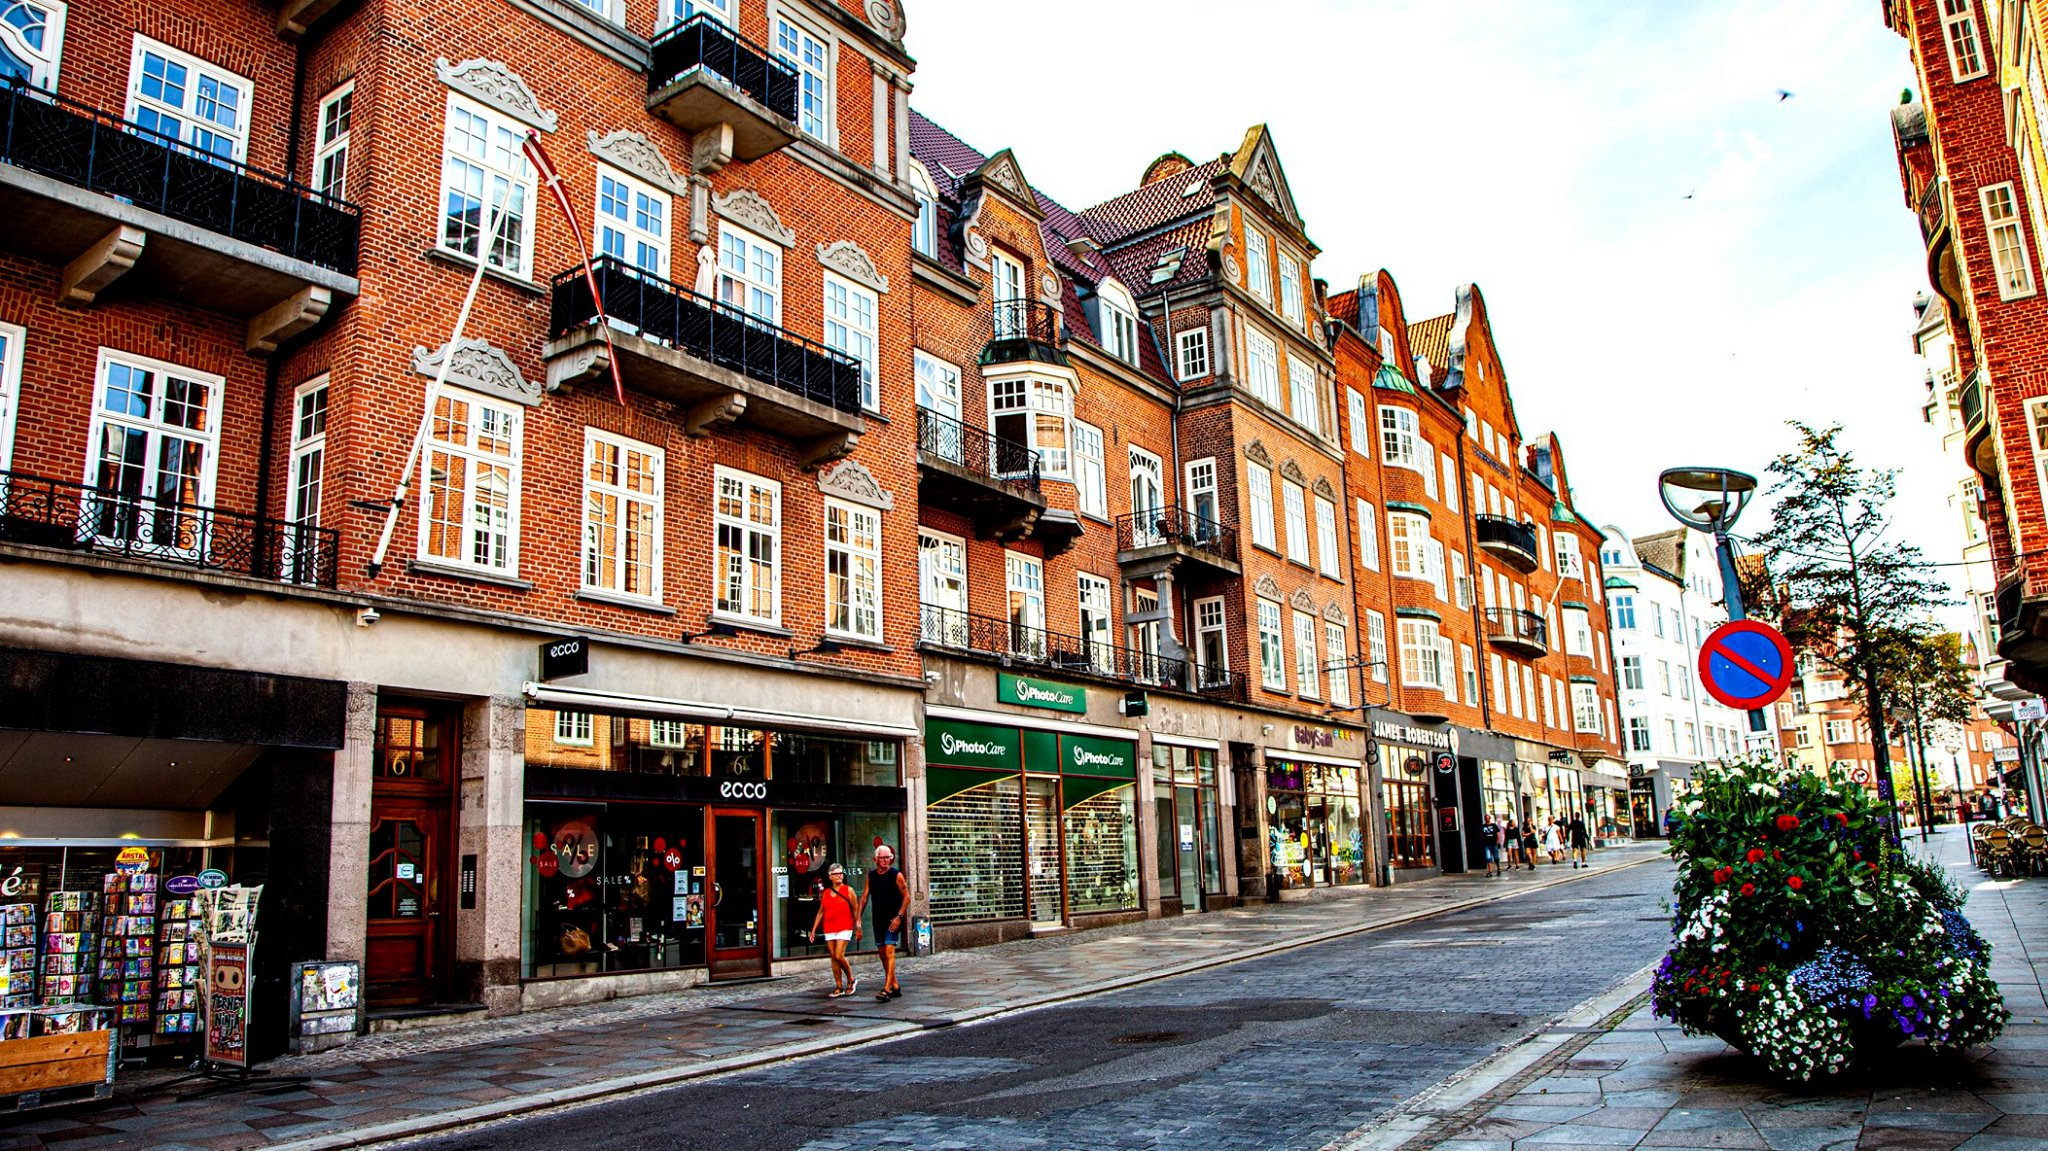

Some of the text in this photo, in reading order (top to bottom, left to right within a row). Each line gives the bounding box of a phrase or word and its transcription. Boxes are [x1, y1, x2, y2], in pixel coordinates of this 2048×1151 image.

[551, 642, 579, 658] ecco
[1028, 687, 1074, 704] PhotoCare
[1374, 720, 1401, 741] JAMES
[1405, 726, 1450, 748] ROBERTSON
[955, 740, 1006, 756] PhotoCare
[392, 754, 406, 776] 6
[1084, 752, 1124, 766] PhotoCare
[720, 781, 767, 799] ecco
[550, 843, 595, 858] SALE
